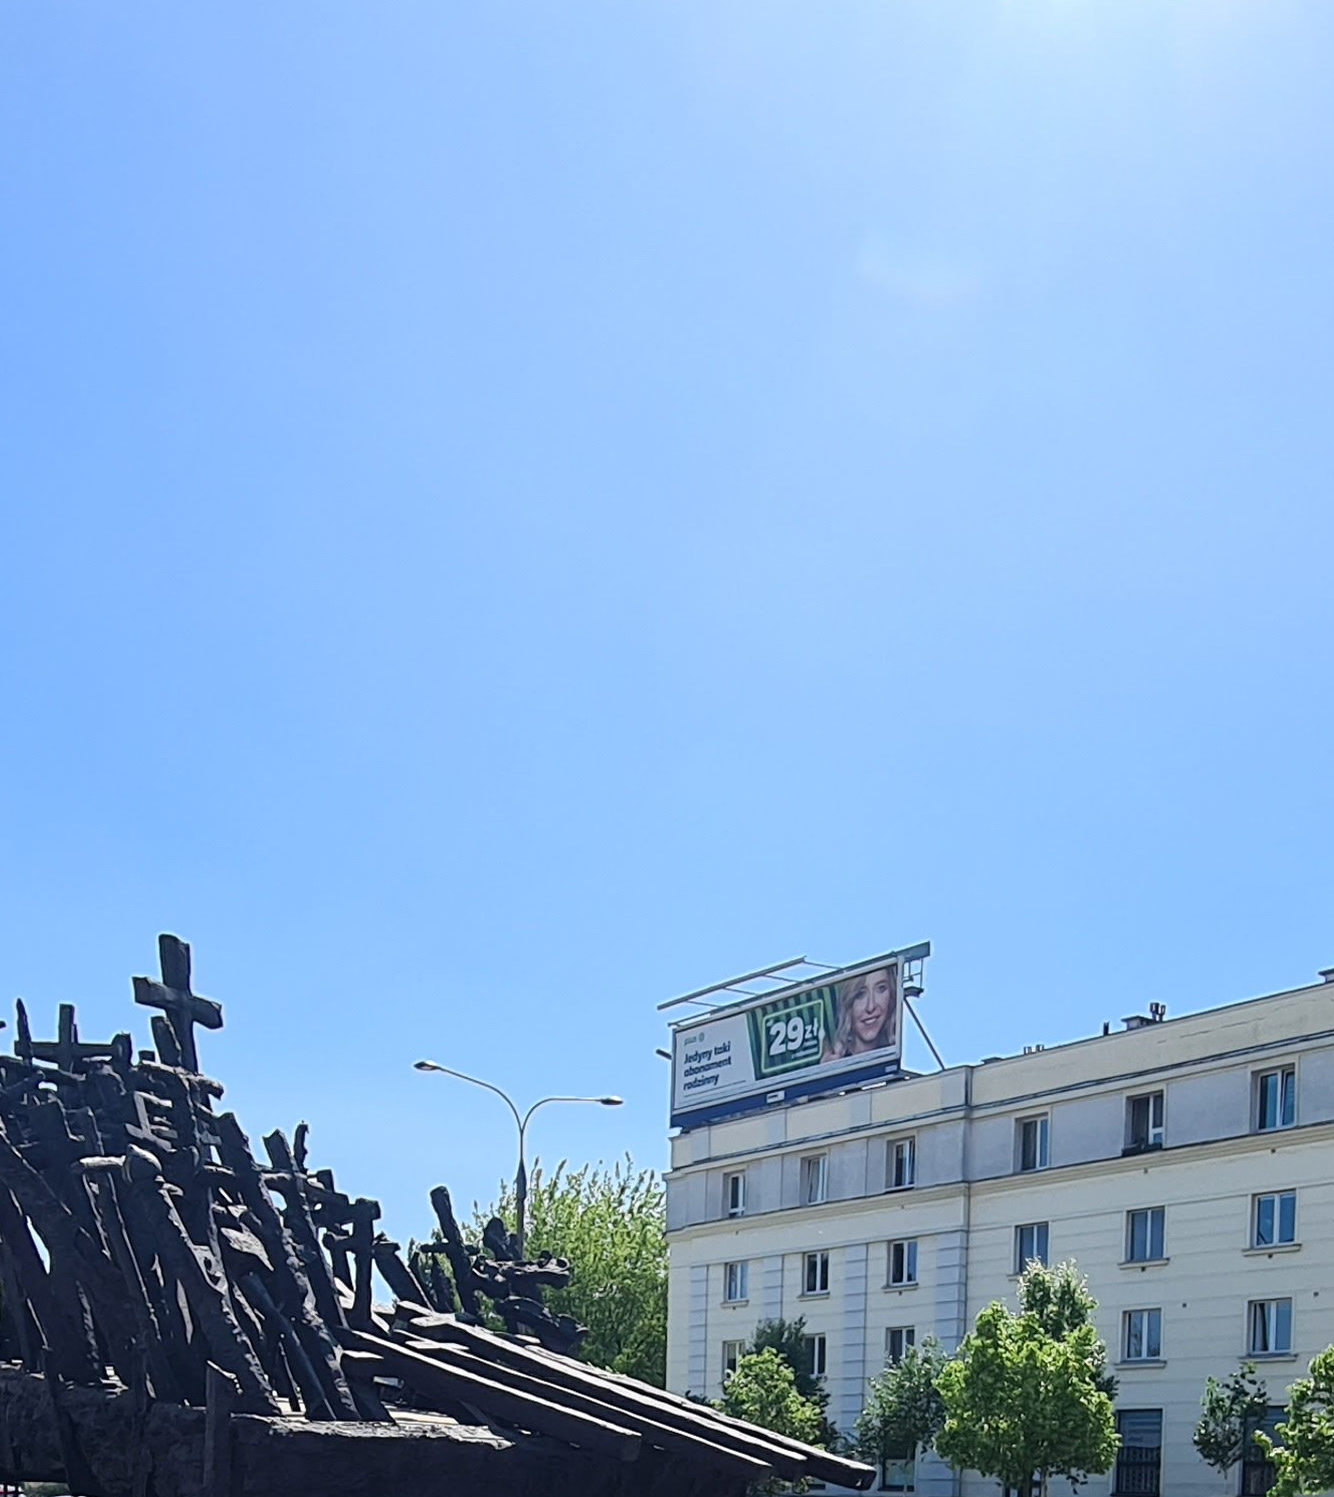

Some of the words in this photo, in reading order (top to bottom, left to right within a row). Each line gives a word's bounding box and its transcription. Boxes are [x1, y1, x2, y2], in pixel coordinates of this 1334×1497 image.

[769, 1016, 804, 1056] 29
[804, 1018, 819, 1039] zł
[684, 1049, 713, 1065] Jedyny
[714, 1041, 732, 1056] taki
[683, 1056, 732, 1078] abonament
[683, 1074, 720, 1091] rodzinny
